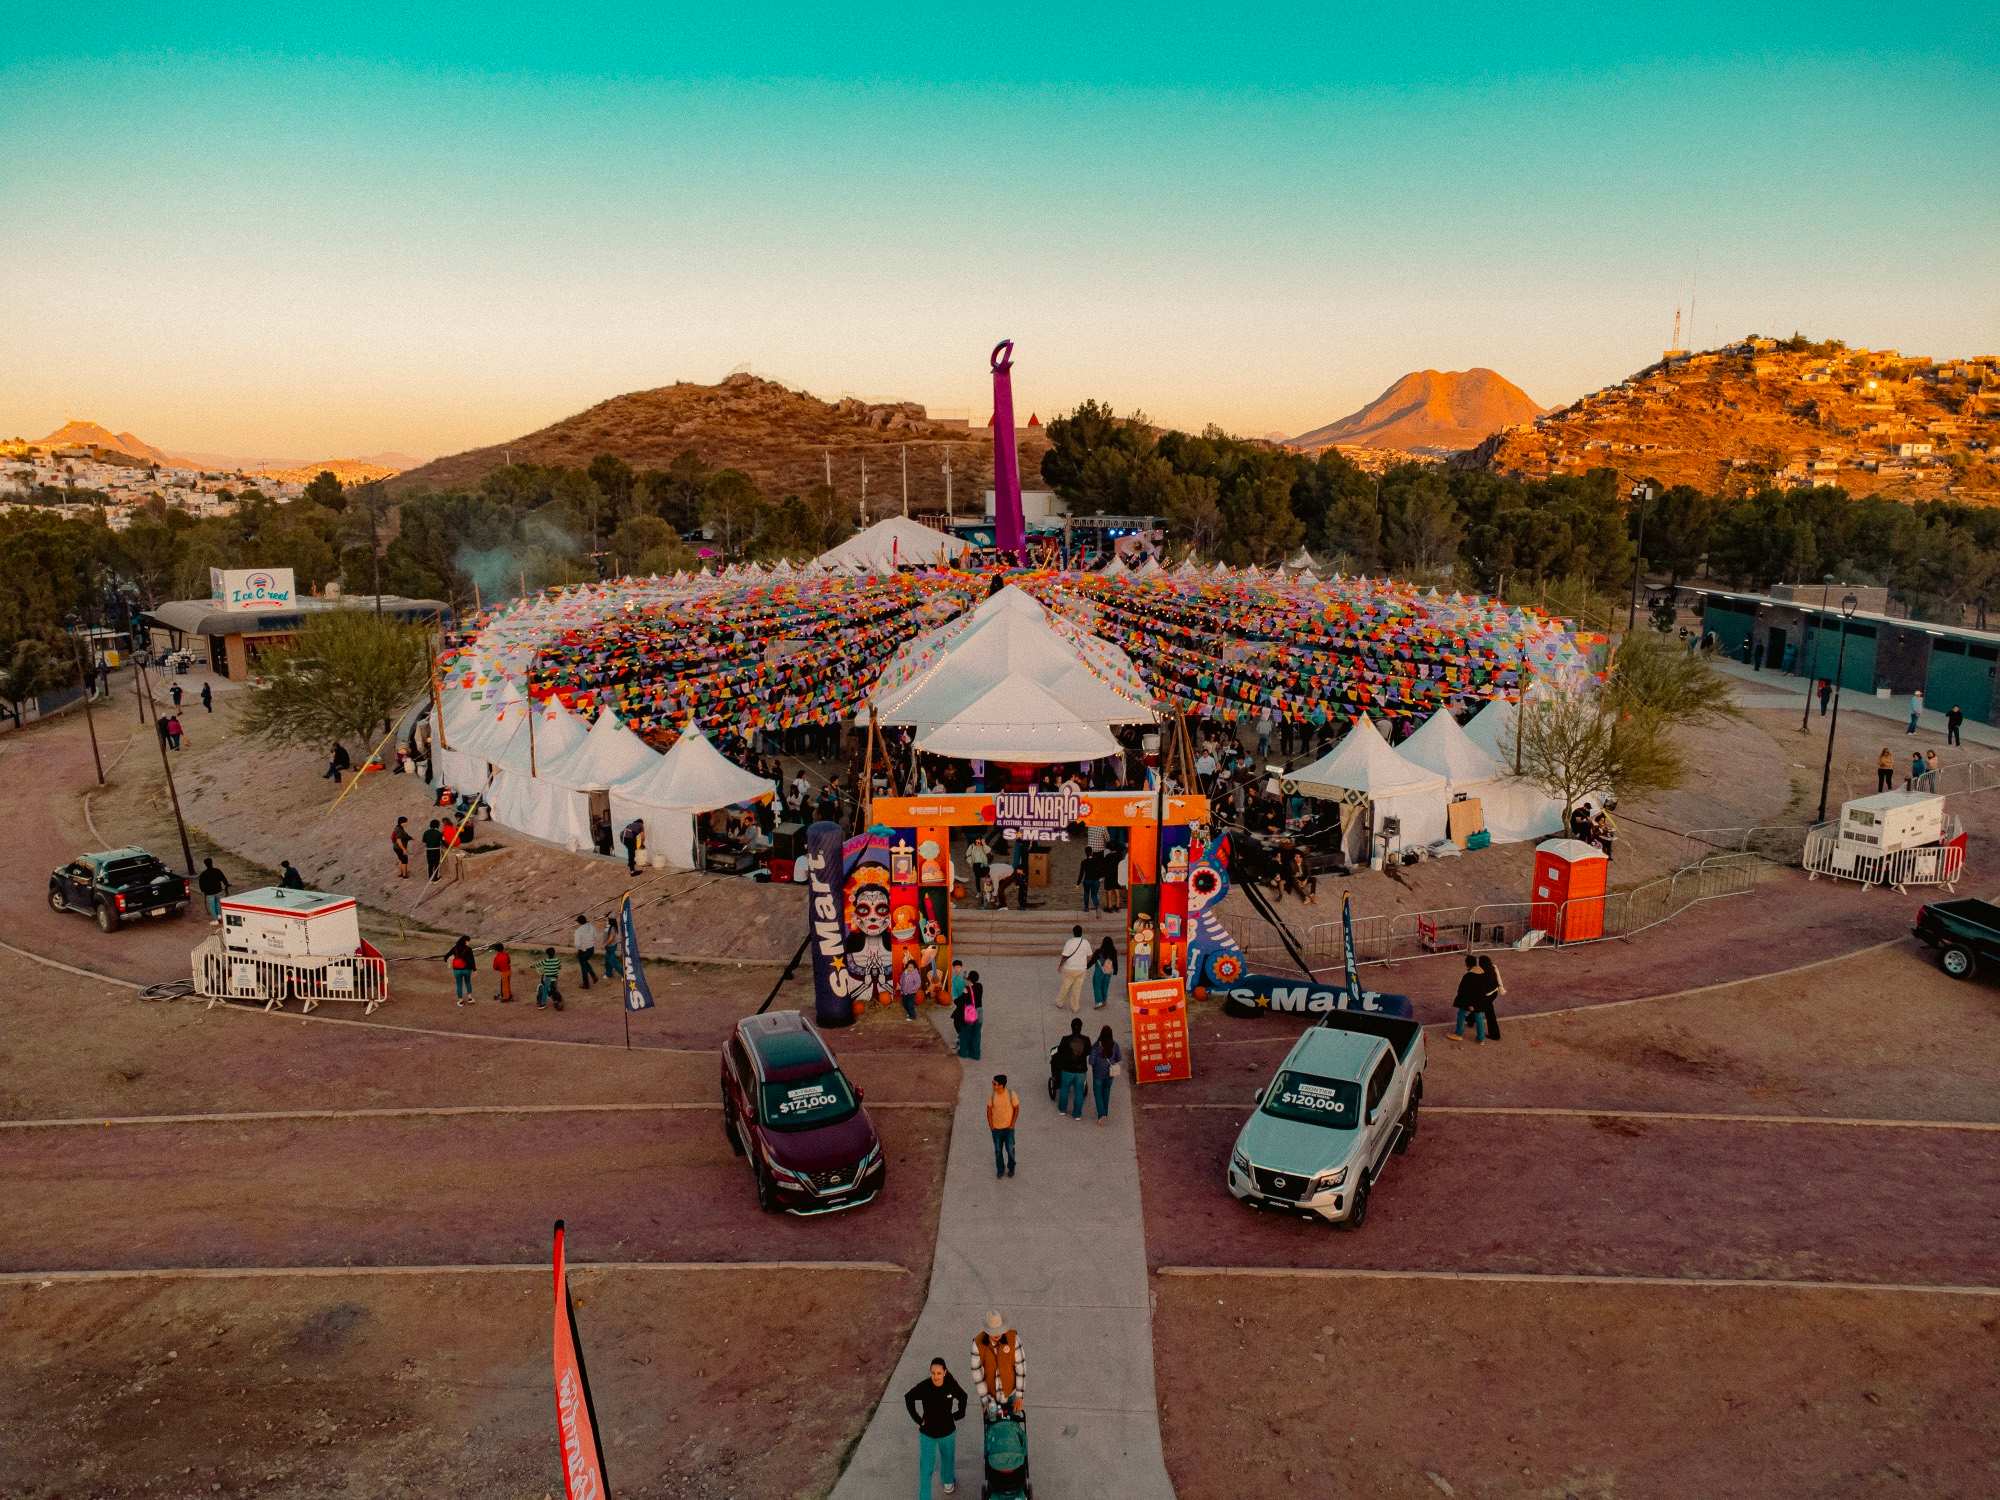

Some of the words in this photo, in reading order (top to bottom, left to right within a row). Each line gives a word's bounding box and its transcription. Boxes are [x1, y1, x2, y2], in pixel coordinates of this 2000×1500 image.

[233, 590, 254, 602] Ice
[996, 787, 1078, 827] CUULINARIA
[1282, 1092, 1345, 1112] $120,000
